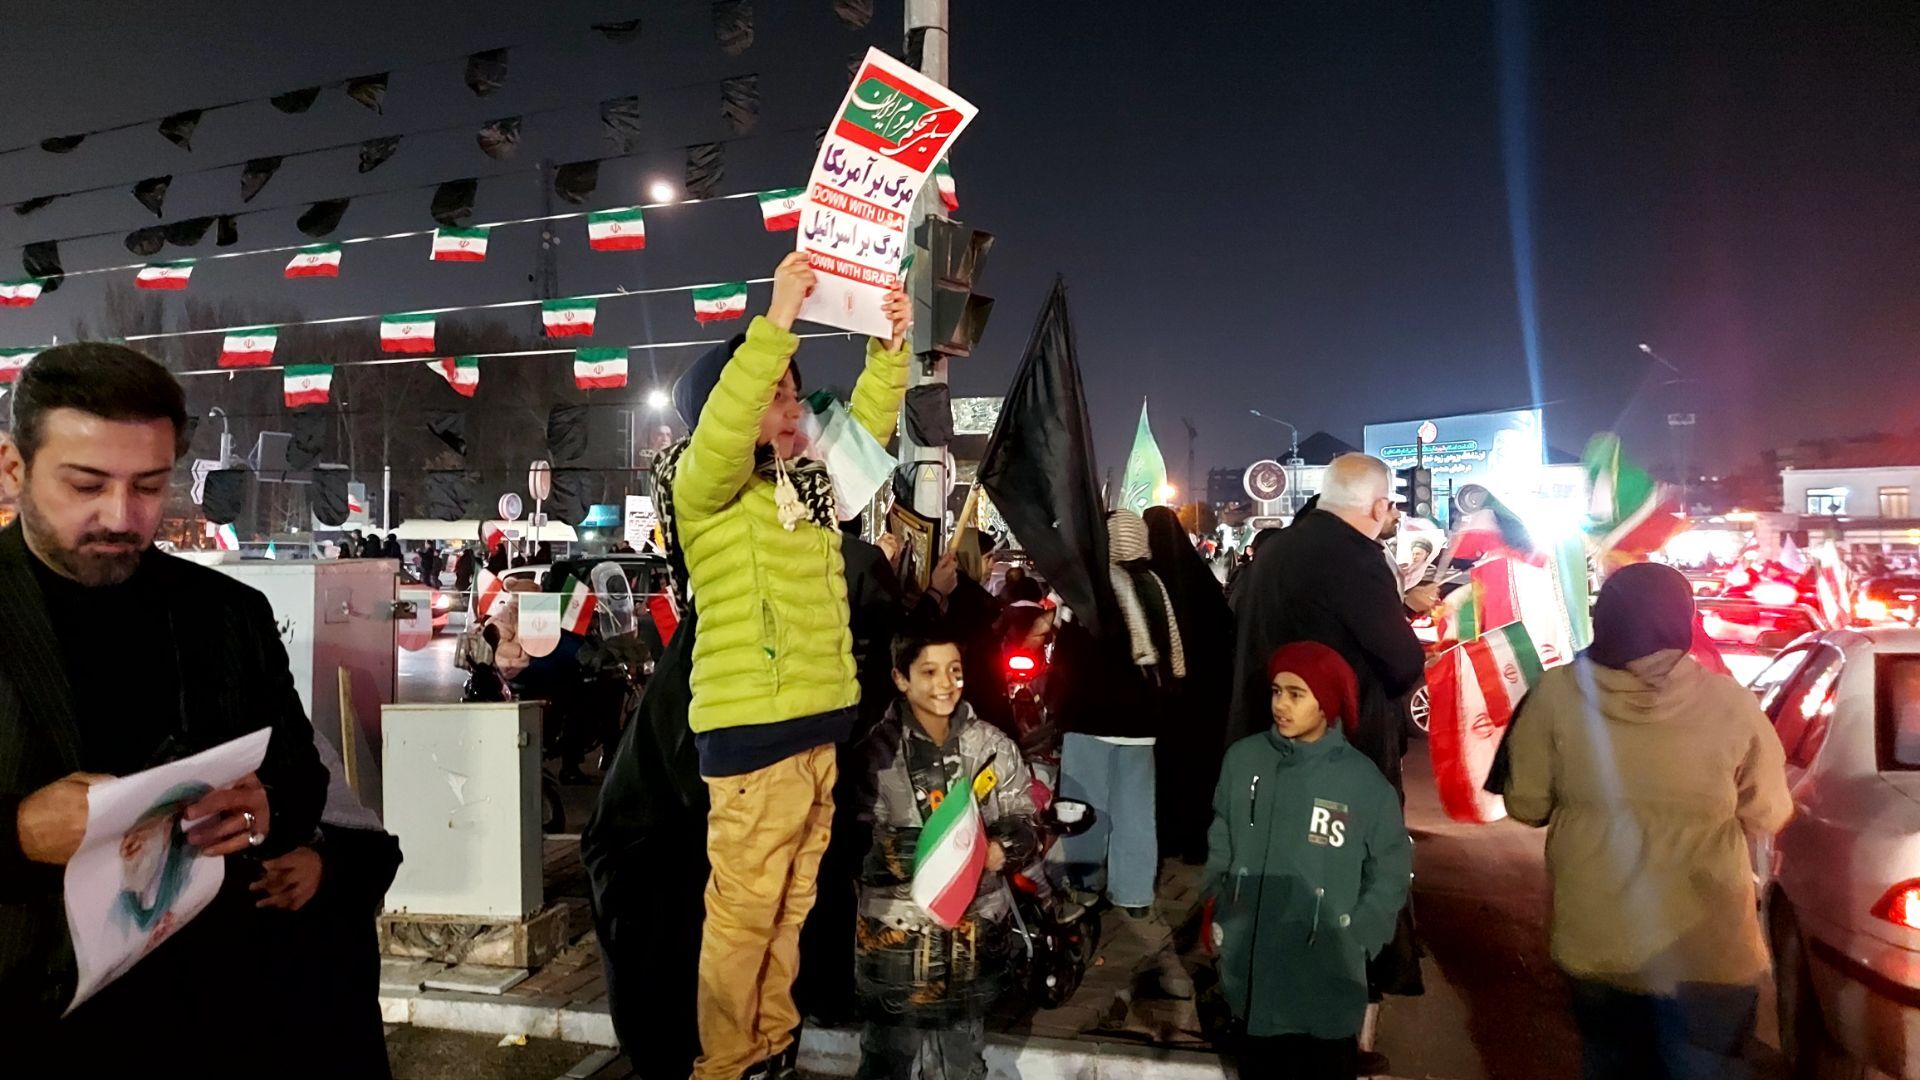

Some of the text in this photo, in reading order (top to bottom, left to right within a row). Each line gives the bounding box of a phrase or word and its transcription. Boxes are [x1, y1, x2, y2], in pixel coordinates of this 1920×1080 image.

[852, 89, 955, 156] سیلی محکم مردم ایران
[812, 183, 848, 209] DOWN
[848, 196, 877, 219] WITH
[823, 143, 913, 208] مرگ بر آمریکا
[805, 210, 900, 264] مرگ بر اسرائیل
[836, 260, 862, 280] WITH
[862, 267, 896, 287] ISRAE
